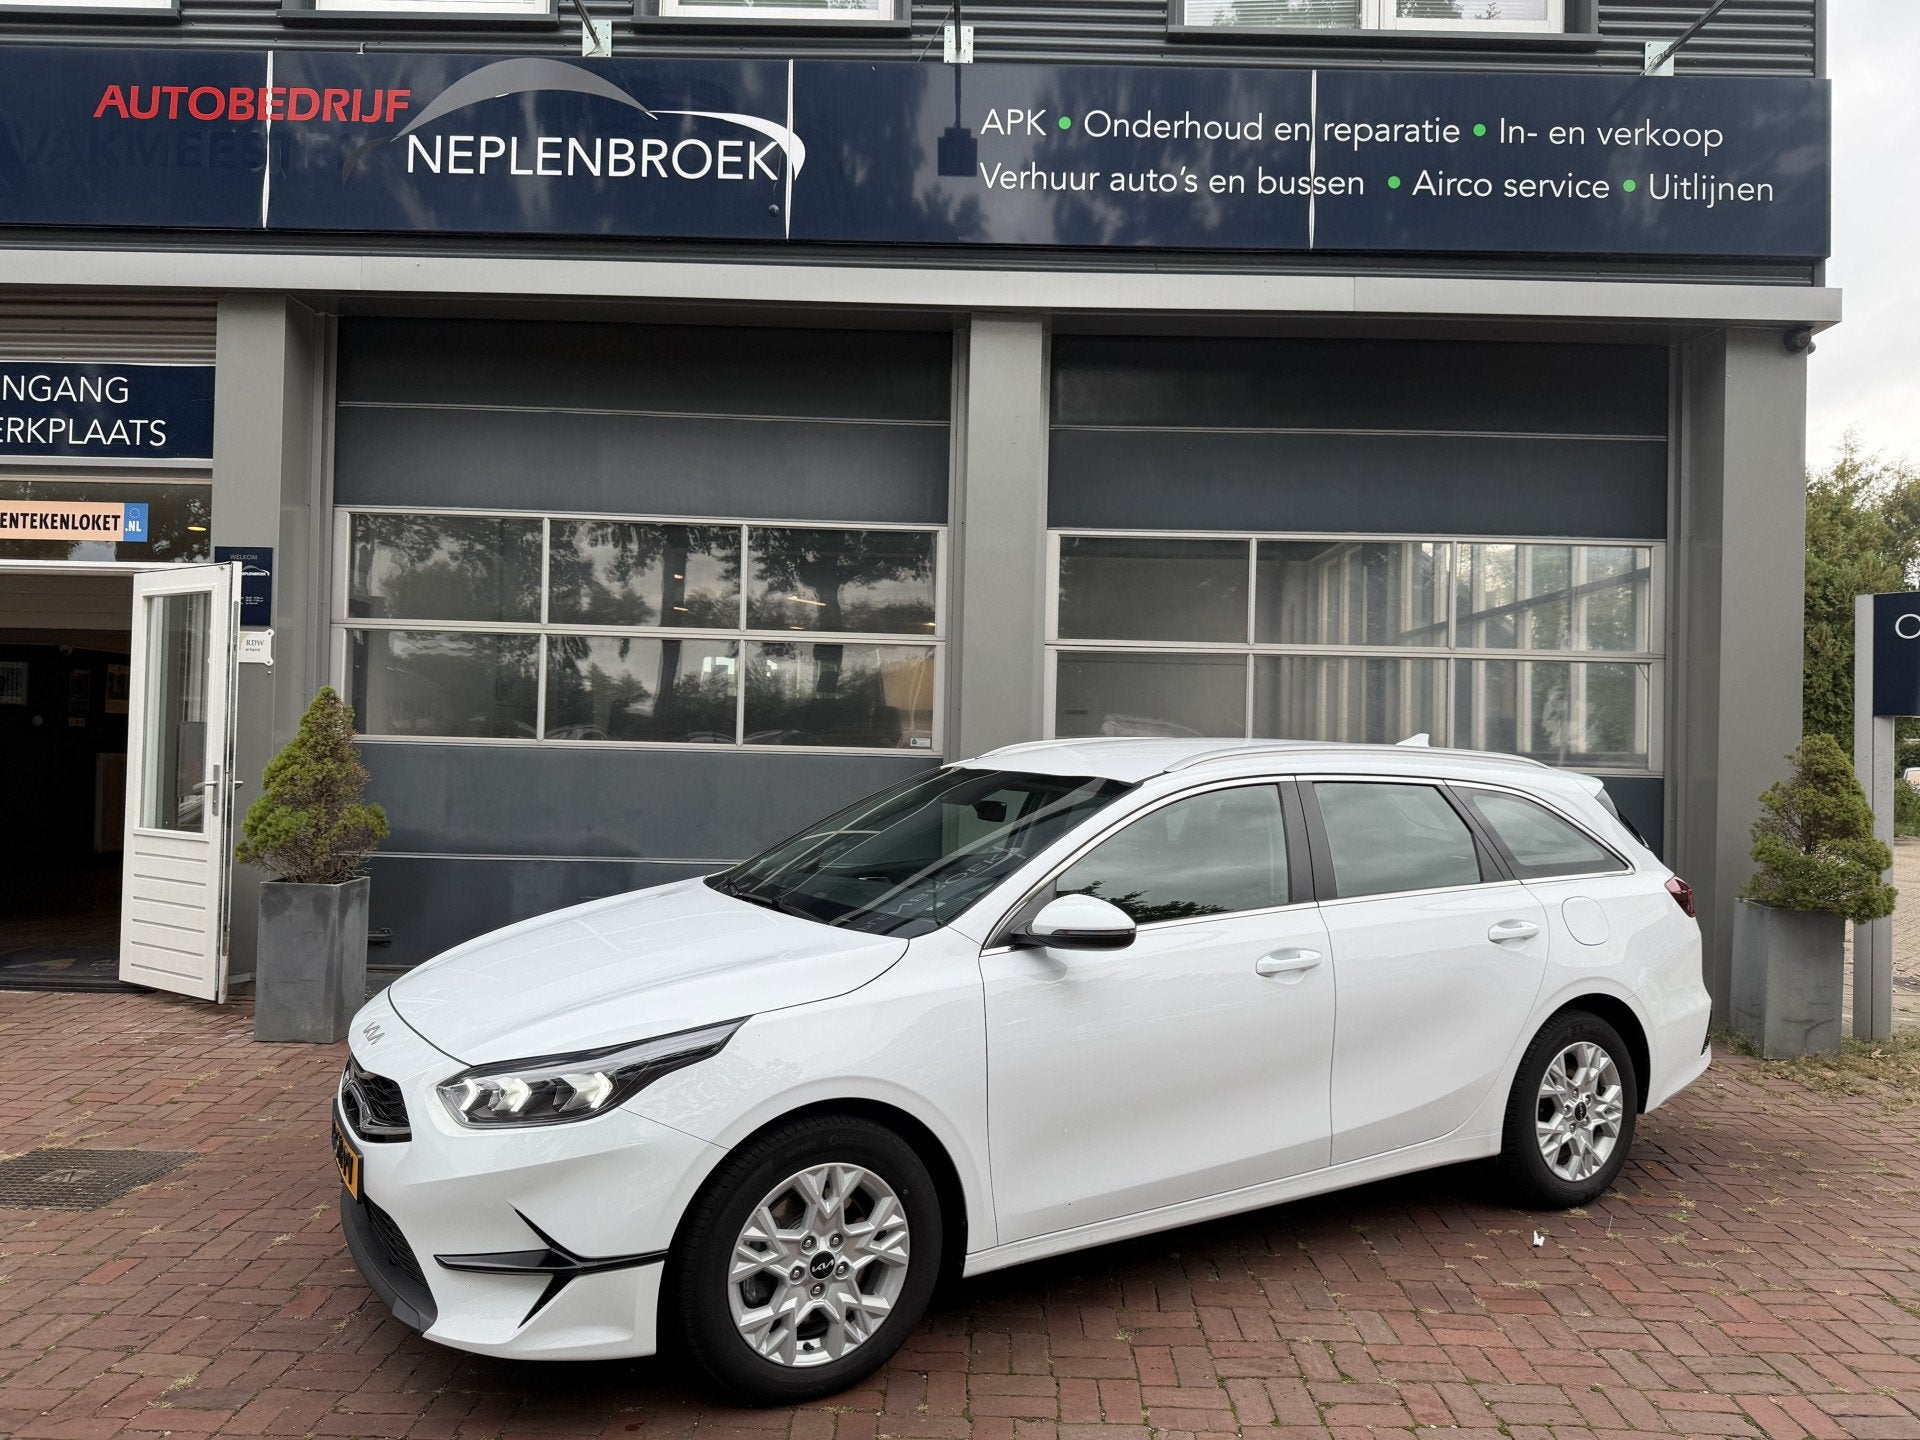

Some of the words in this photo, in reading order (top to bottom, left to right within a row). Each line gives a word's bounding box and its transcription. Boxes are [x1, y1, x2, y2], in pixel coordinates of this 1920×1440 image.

[93, 85, 411, 123] AUTOBEDRIJF
[980, 108, 1047, 136] APK
[1084, 109, 1264, 141] Onderhoud
[1274, 123, 1310, 142] en
[1324, 117, 1461, 151] reparatie
[1500, 117, 1538, 144] In-
[1549, 126, 1585, 145] en
[1596, 118, 1724, 156] verkoop
[407, 134, 779, 181] NEPLENBROEK
[979, 162, 1101, 191] Verhuur
[1208, 175, 1245, 194] en
[1257, 166, 1365, 195] bussen
[1411, 169, 1493, 197] Airco
[1503, 172, 1610, 199] service
[1649, 173, 1773, 208] Uitlijnen
[0, 416, 167, 447] RKPLAATS
